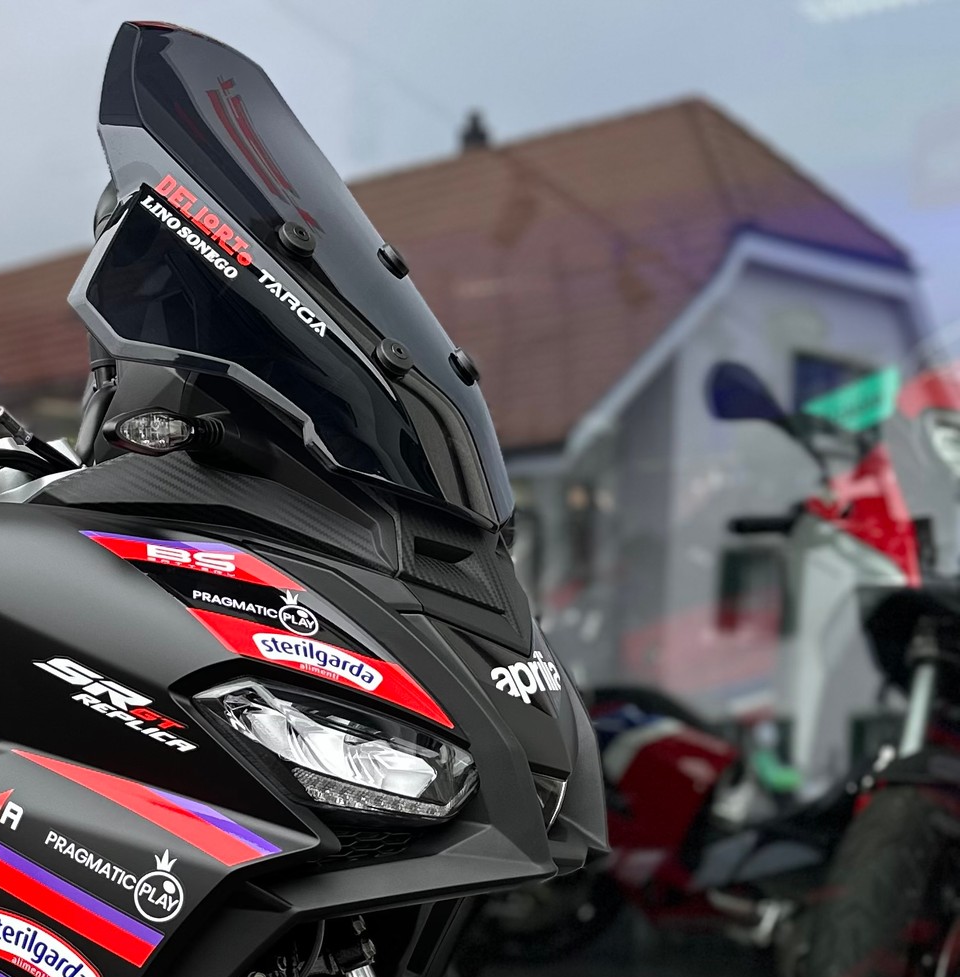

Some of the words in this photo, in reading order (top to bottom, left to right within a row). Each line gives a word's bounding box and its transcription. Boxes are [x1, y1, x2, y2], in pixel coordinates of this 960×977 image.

[139, 194, 183, 231] LINO
[176, 226, 239, 280] SONEGO
[257, 268, 328, 338] TARGA
[146, 543, 236, 572] BS
[192, 589, 278, 619] PRAGMATIC
[283, 611, 317, 630] PLAY
[261, 636, 375, 686] sterilgarda
[299, 662, 340, 682] alimenti
[32, 656, 154, 713] SR
[129, 705, 187, 731] GT
[70, 693, 198, 753] REPLICA
[44, 830, 137, 891] PRAGMATIC
[138, 881, 180, 913] PLAY
